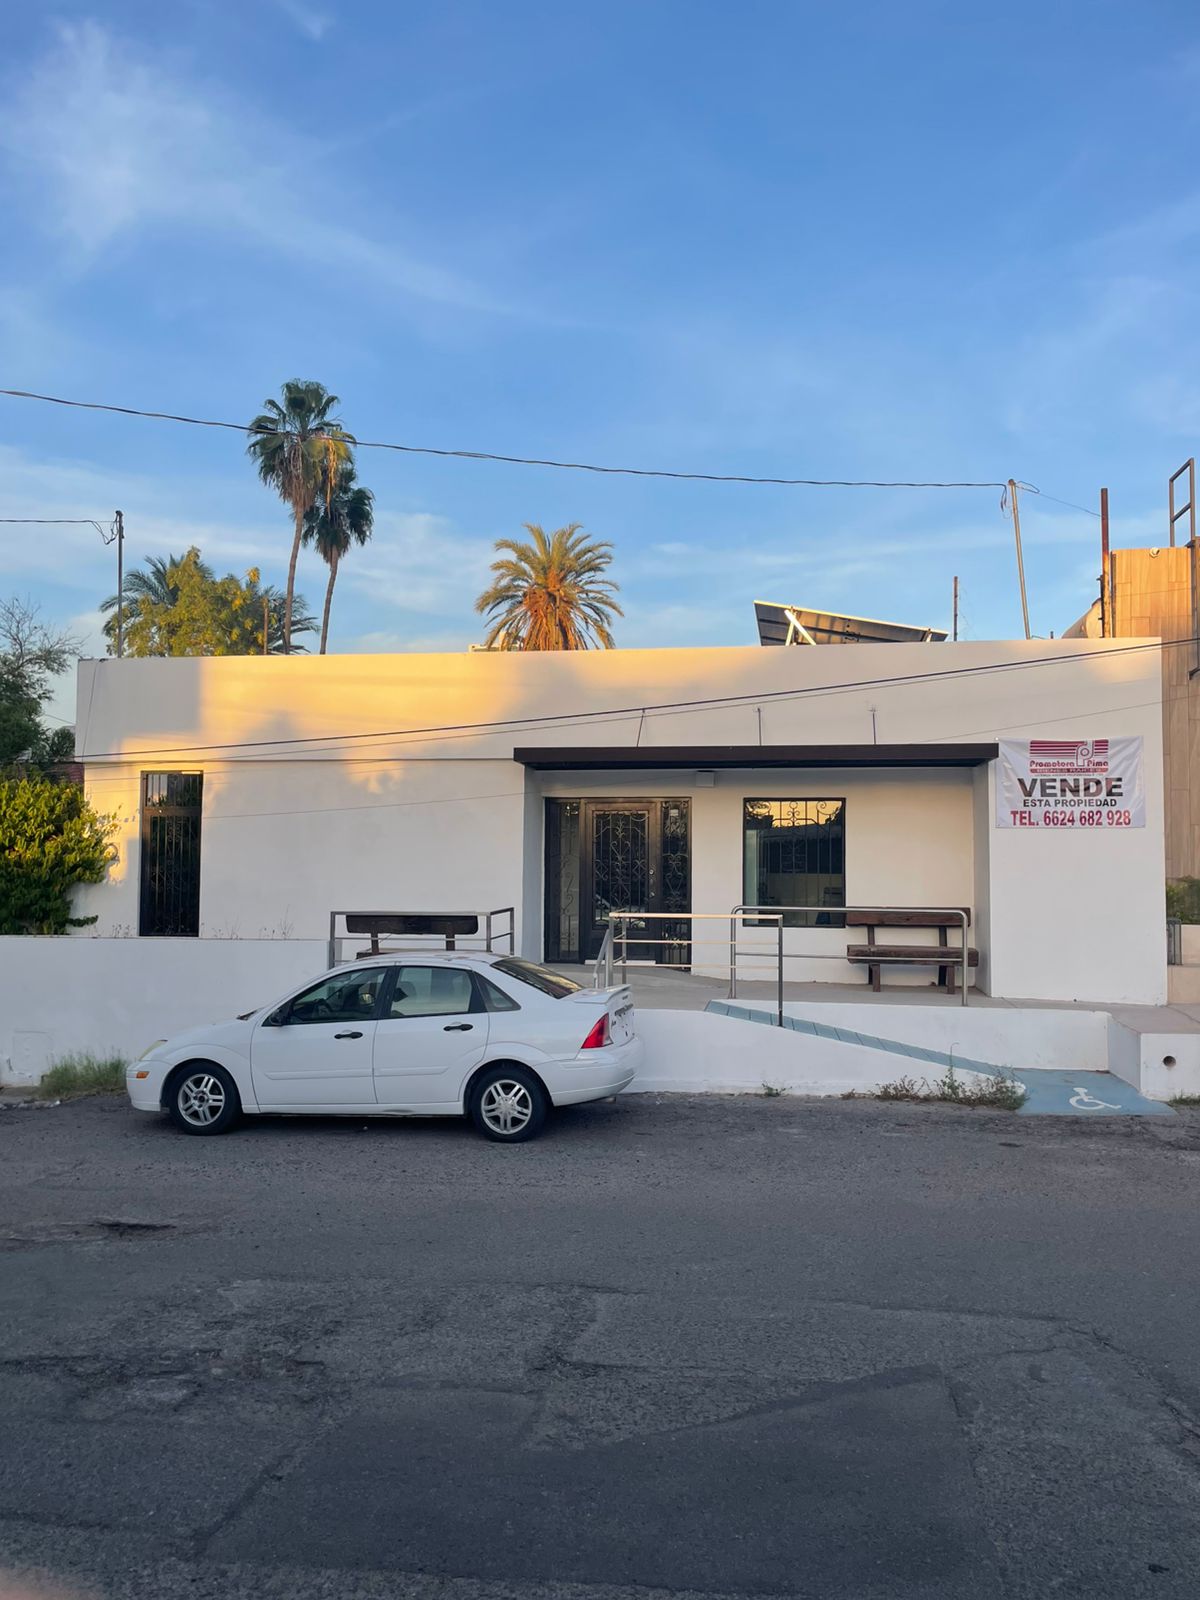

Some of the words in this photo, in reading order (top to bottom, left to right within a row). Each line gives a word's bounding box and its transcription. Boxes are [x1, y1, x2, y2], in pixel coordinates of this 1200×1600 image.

[1017, 777, 1123, 797] VENDE
[1023, 799, 1051, 807] ESTA
[1055, 798, 1117, 807] PROPIEDAD
[1010, 811, 1039, 826] TEL.
[1043, 810, 1075, 826] 6624
[1079, 810, 1103, 826] 682
[1106, 809, 1131, 826] 928
